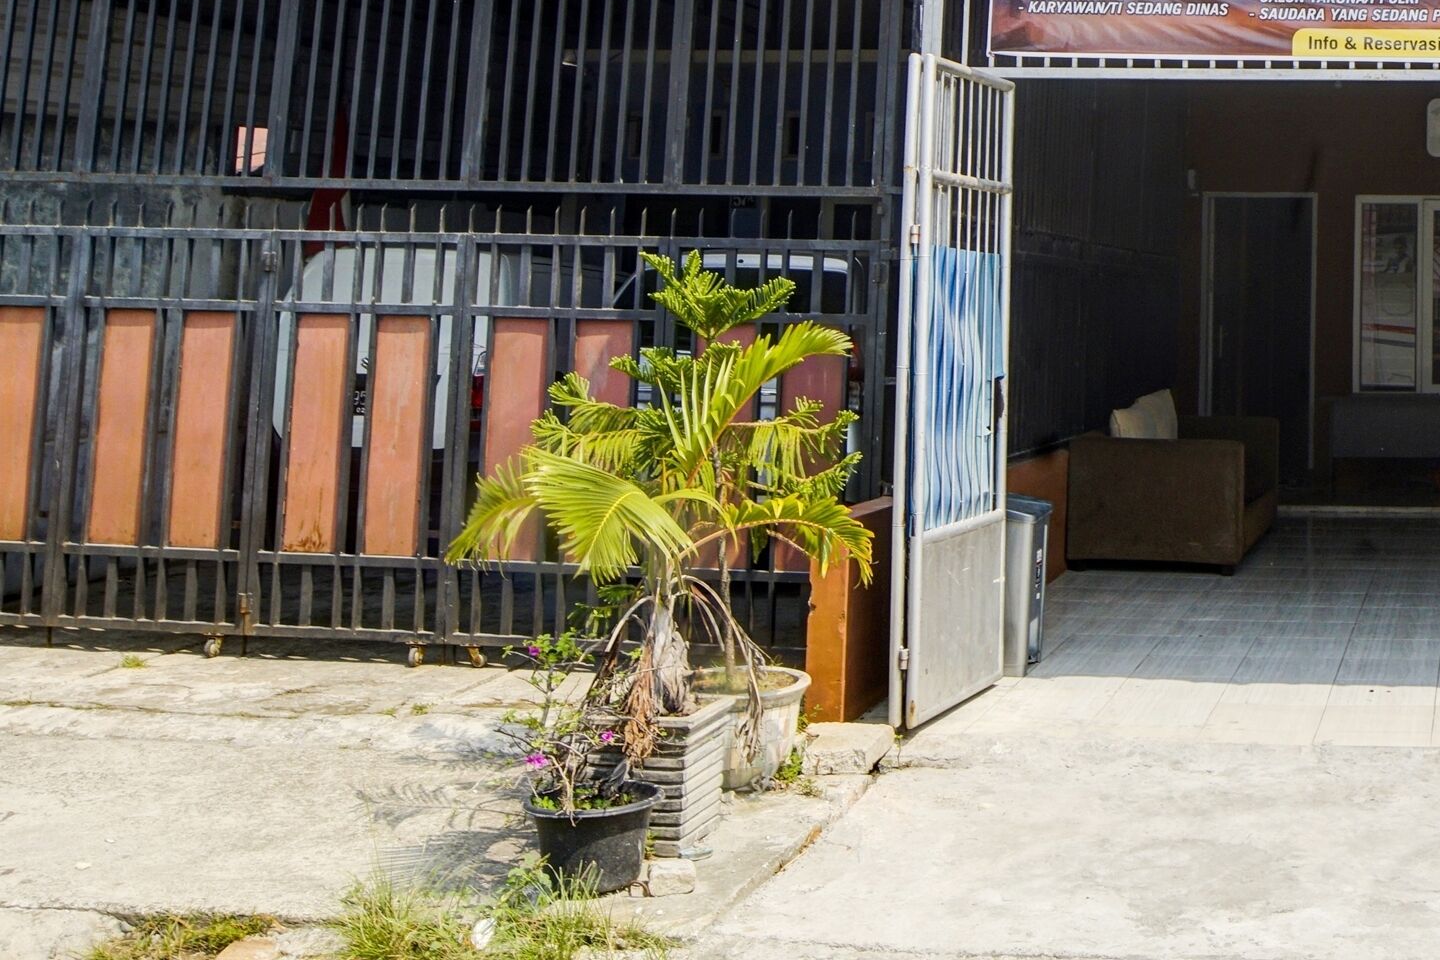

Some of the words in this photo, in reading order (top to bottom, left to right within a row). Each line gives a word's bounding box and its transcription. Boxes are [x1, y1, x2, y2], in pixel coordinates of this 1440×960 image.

[1028, 1, 1122, 15] KARYAWAN/TI
[1126, 2, 1182, 15] SEDANG
[1186, 3, 1229, 16] DINAS
[1259, 7, 1325, 21] SAUDARA
[1330, 8, 1367, 21] YANG
[1371, 8, 1428, 22] SEDANG
[1308, 36, 1338, 50] Info
[1344, 36, 1357, 50] &
